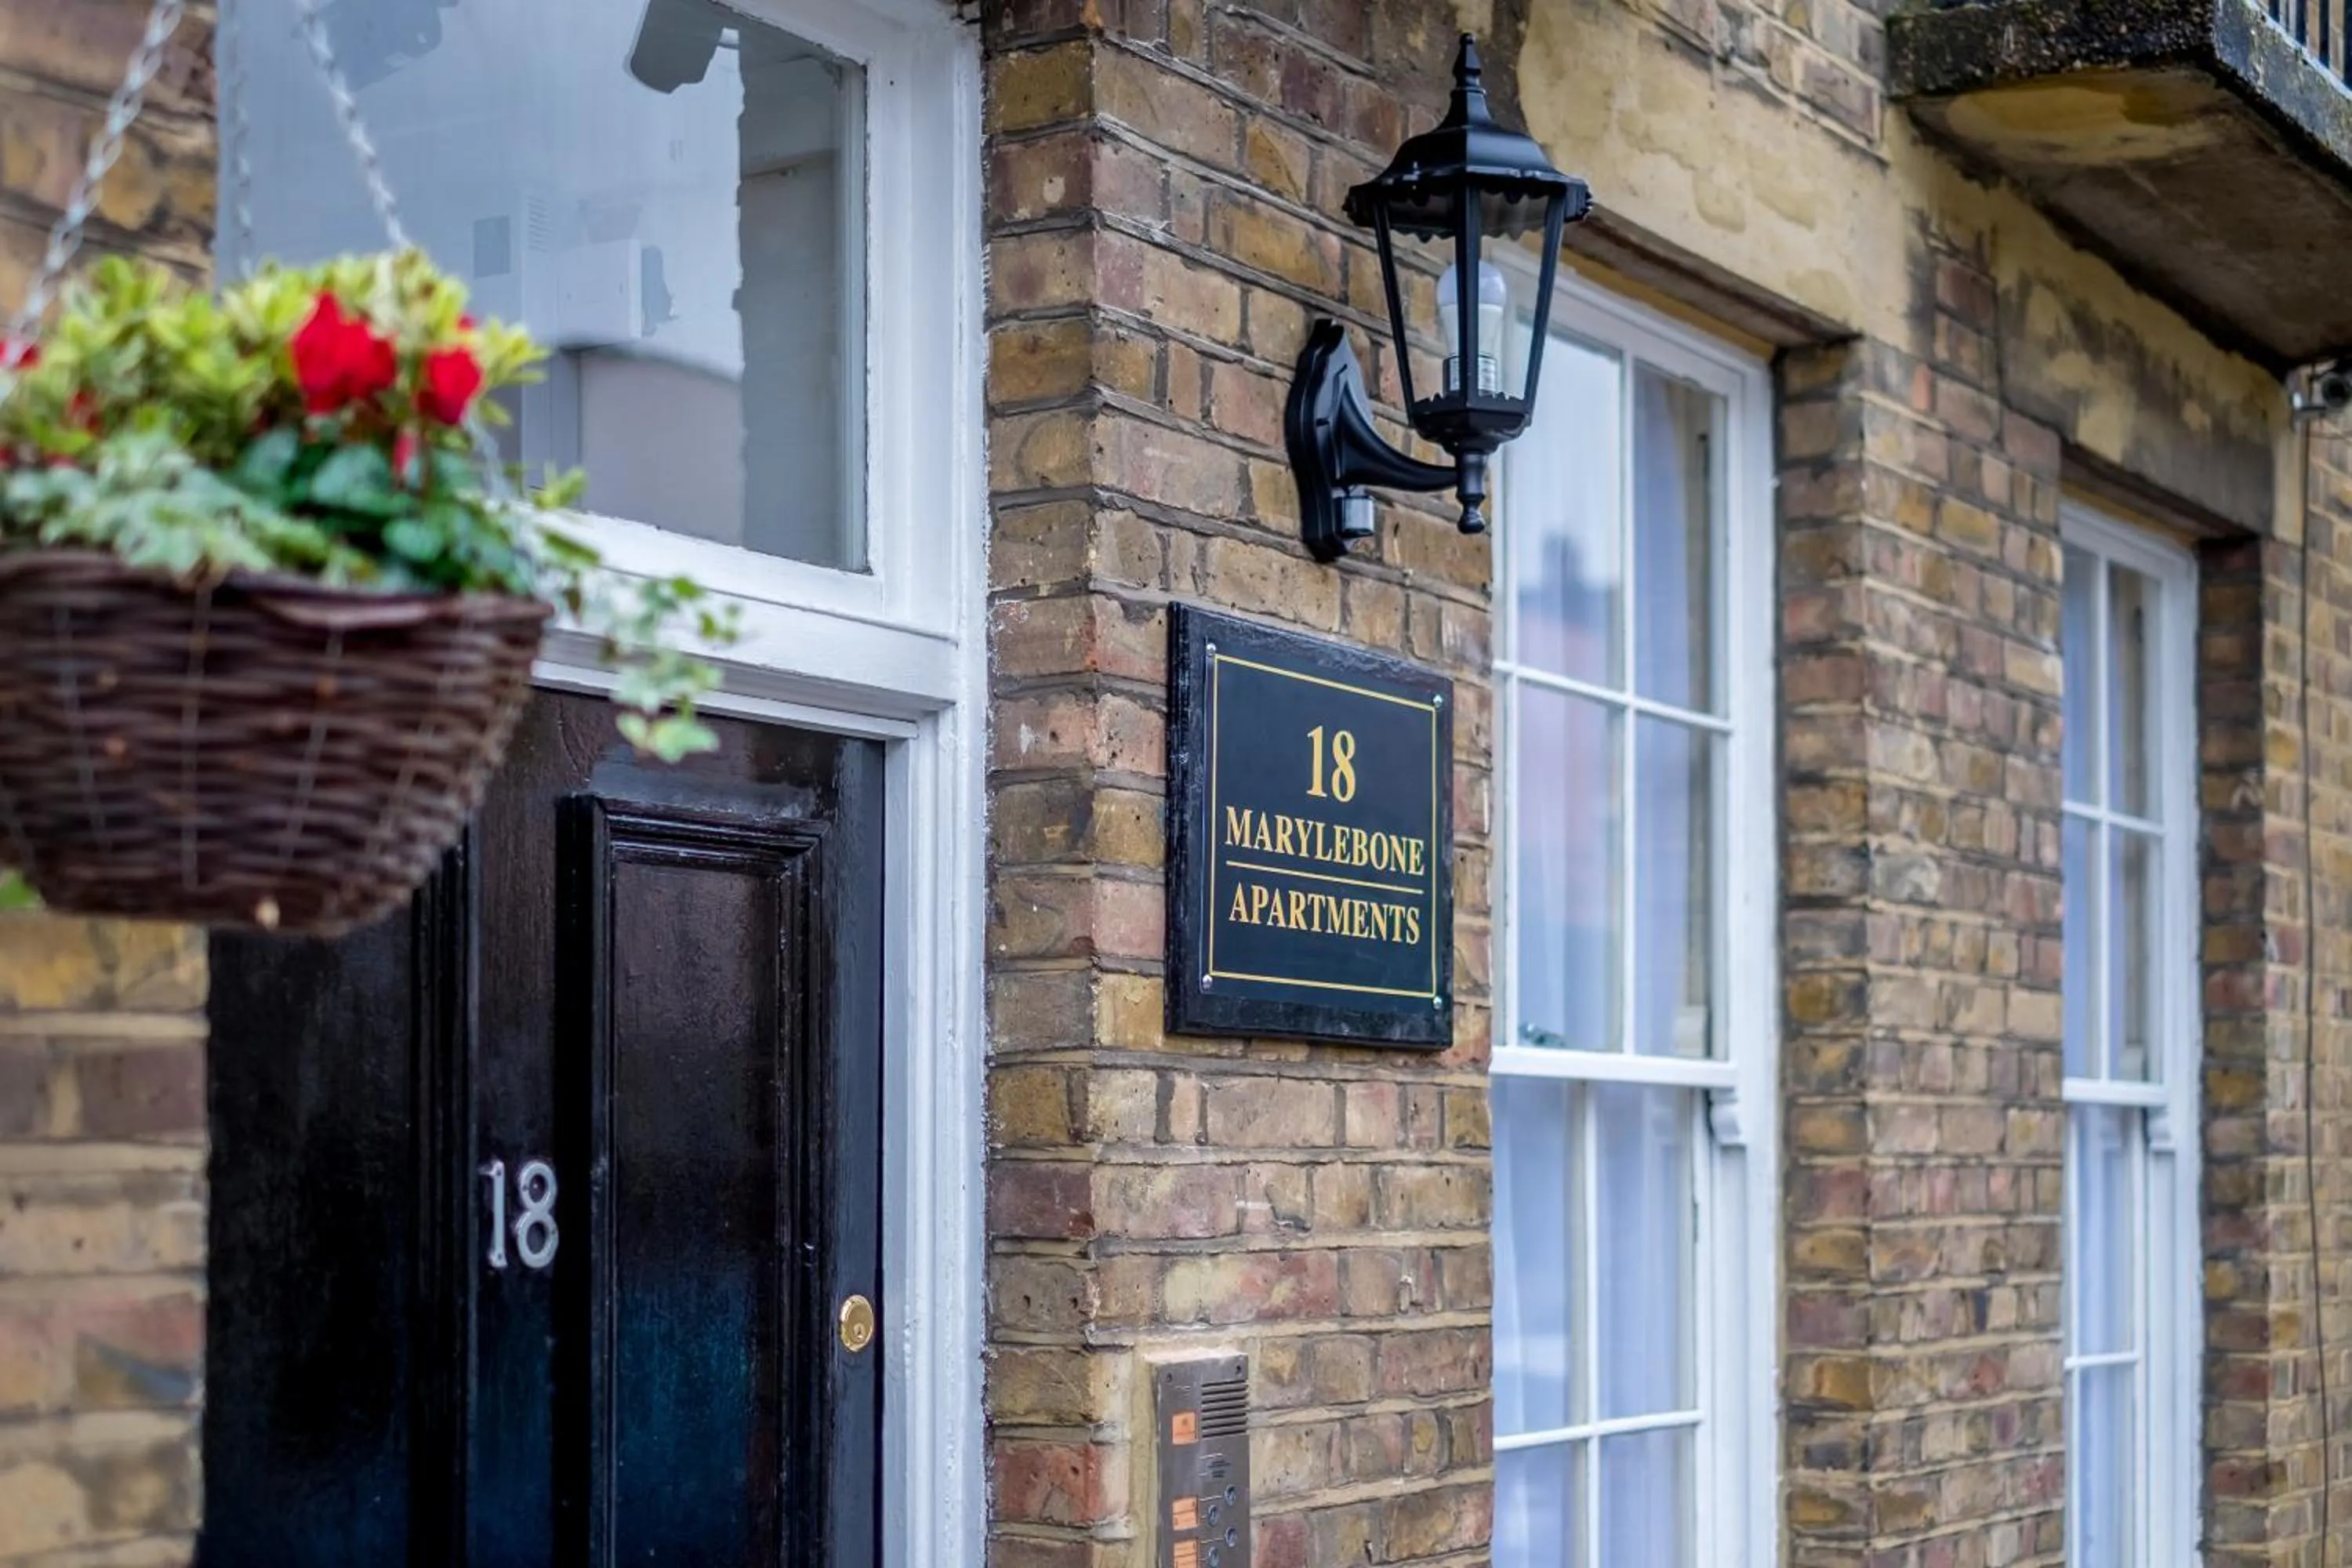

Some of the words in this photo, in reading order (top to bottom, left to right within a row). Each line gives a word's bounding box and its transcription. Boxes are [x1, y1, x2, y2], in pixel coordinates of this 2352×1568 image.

[1307, 726, 1356, 802] 18
[1225, 806, 1425, 876] MARYLEBONE
[1229, 882, 1420, 945] APARTMENTS
[477, 1160, 558, 1269] 18
